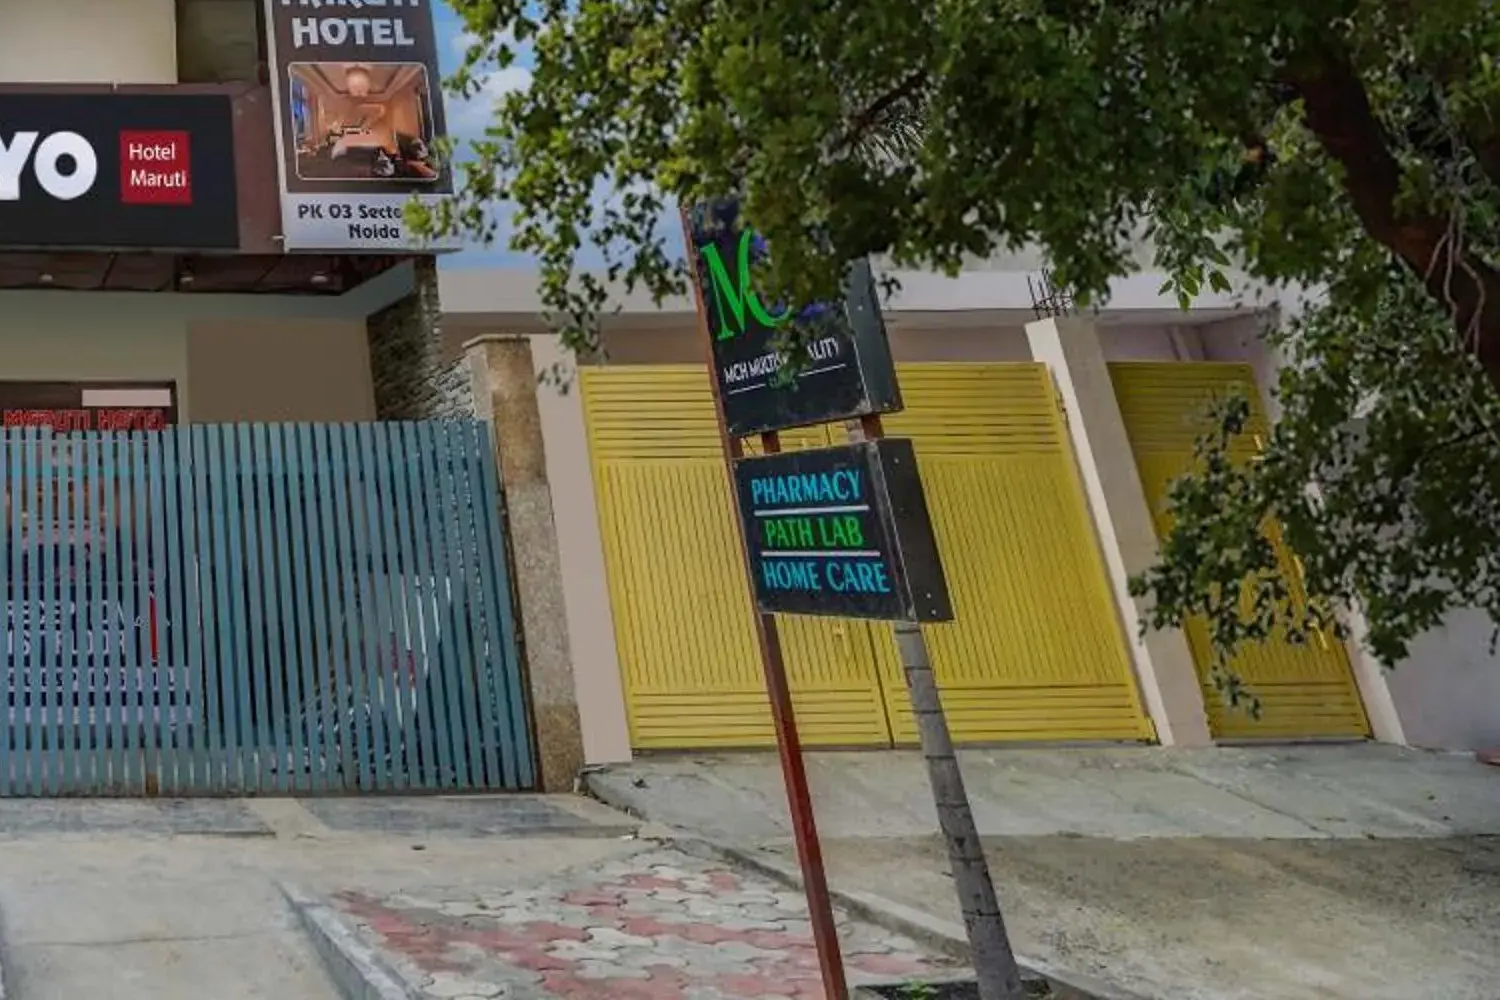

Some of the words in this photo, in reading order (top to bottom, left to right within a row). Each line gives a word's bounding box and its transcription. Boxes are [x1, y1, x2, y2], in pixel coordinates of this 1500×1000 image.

[291, 17, 415, 49] HOTEL
[129, 143, 176, 160] Hotel
[130, 168, 187, 188] Maruti
[298, 204, 322, 219] PK
[329, 204, 352, 219] 03
[358, 204, 404, 219] Secto
[349, 224, 400, 239] Noida
[751, 469, 860, 504] PHARMACY
[764, 517, 814, 547] PATH
[818, 515, 863, 546] LAB
[762, 561, 821, 590] HOME
[825, 562, 890, 593] CARE
